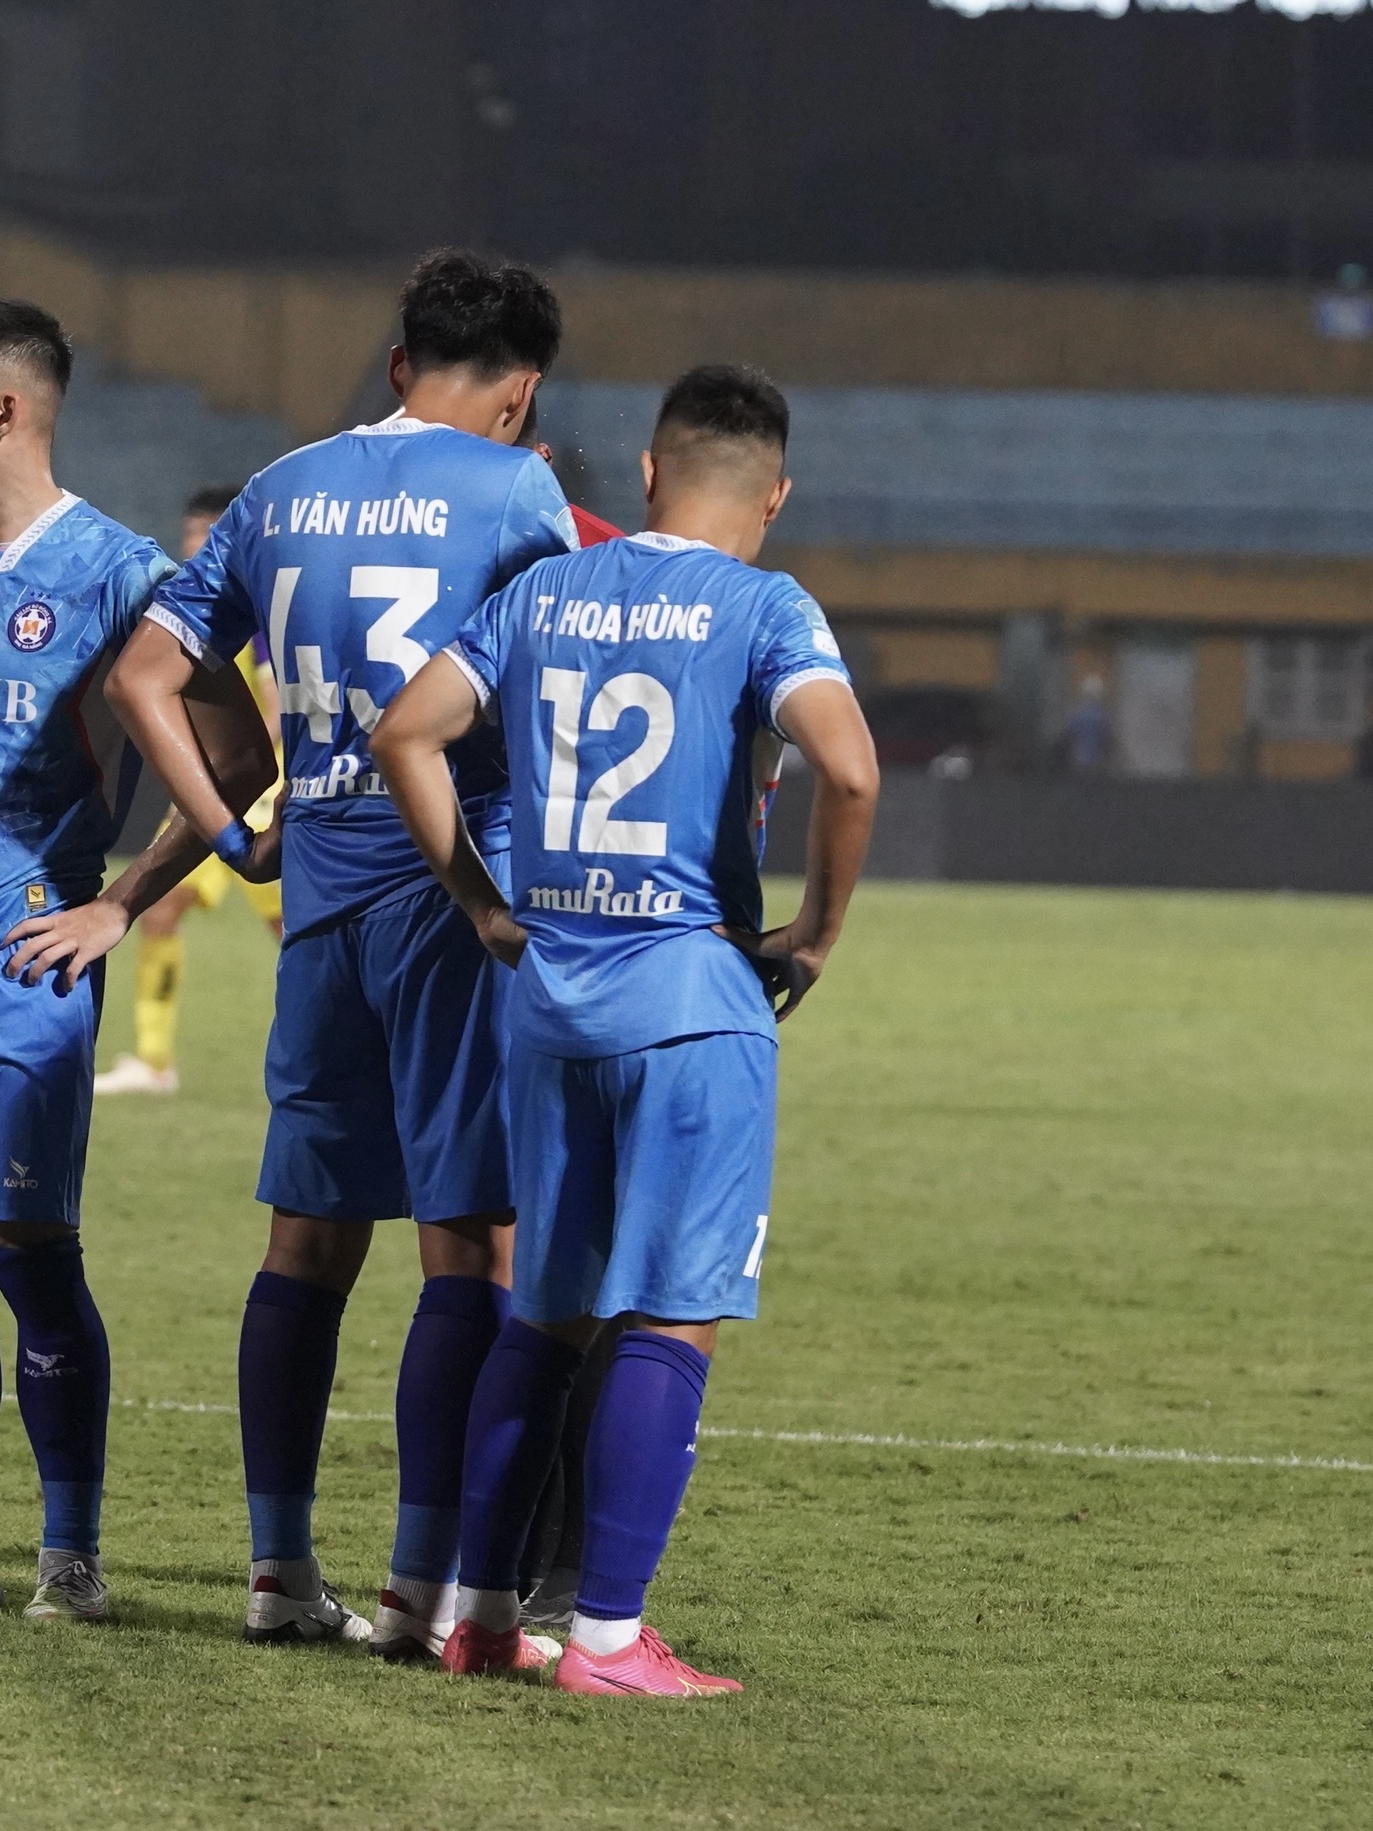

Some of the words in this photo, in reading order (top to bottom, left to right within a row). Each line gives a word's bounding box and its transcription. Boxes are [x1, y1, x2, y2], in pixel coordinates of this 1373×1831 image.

[263, 503, 281, 537] L.
[290, 491, 351, 536] VĂN
[356, 490, 449, 538] HƯNG
[533, 595, 555, 633] T.
[557, 599, 622, 643] HOA
[626, 593, 713, 642] HÙNG
[270, 565, 440, 744] 43
[289, 753, 391, 799] muRa
[539, 666, 675, 857] 12
[527, 867, 685, 918] muRata
[3, 1177, 39, 1190] KAMITO
[742, 1214, 769, 1280] 1
